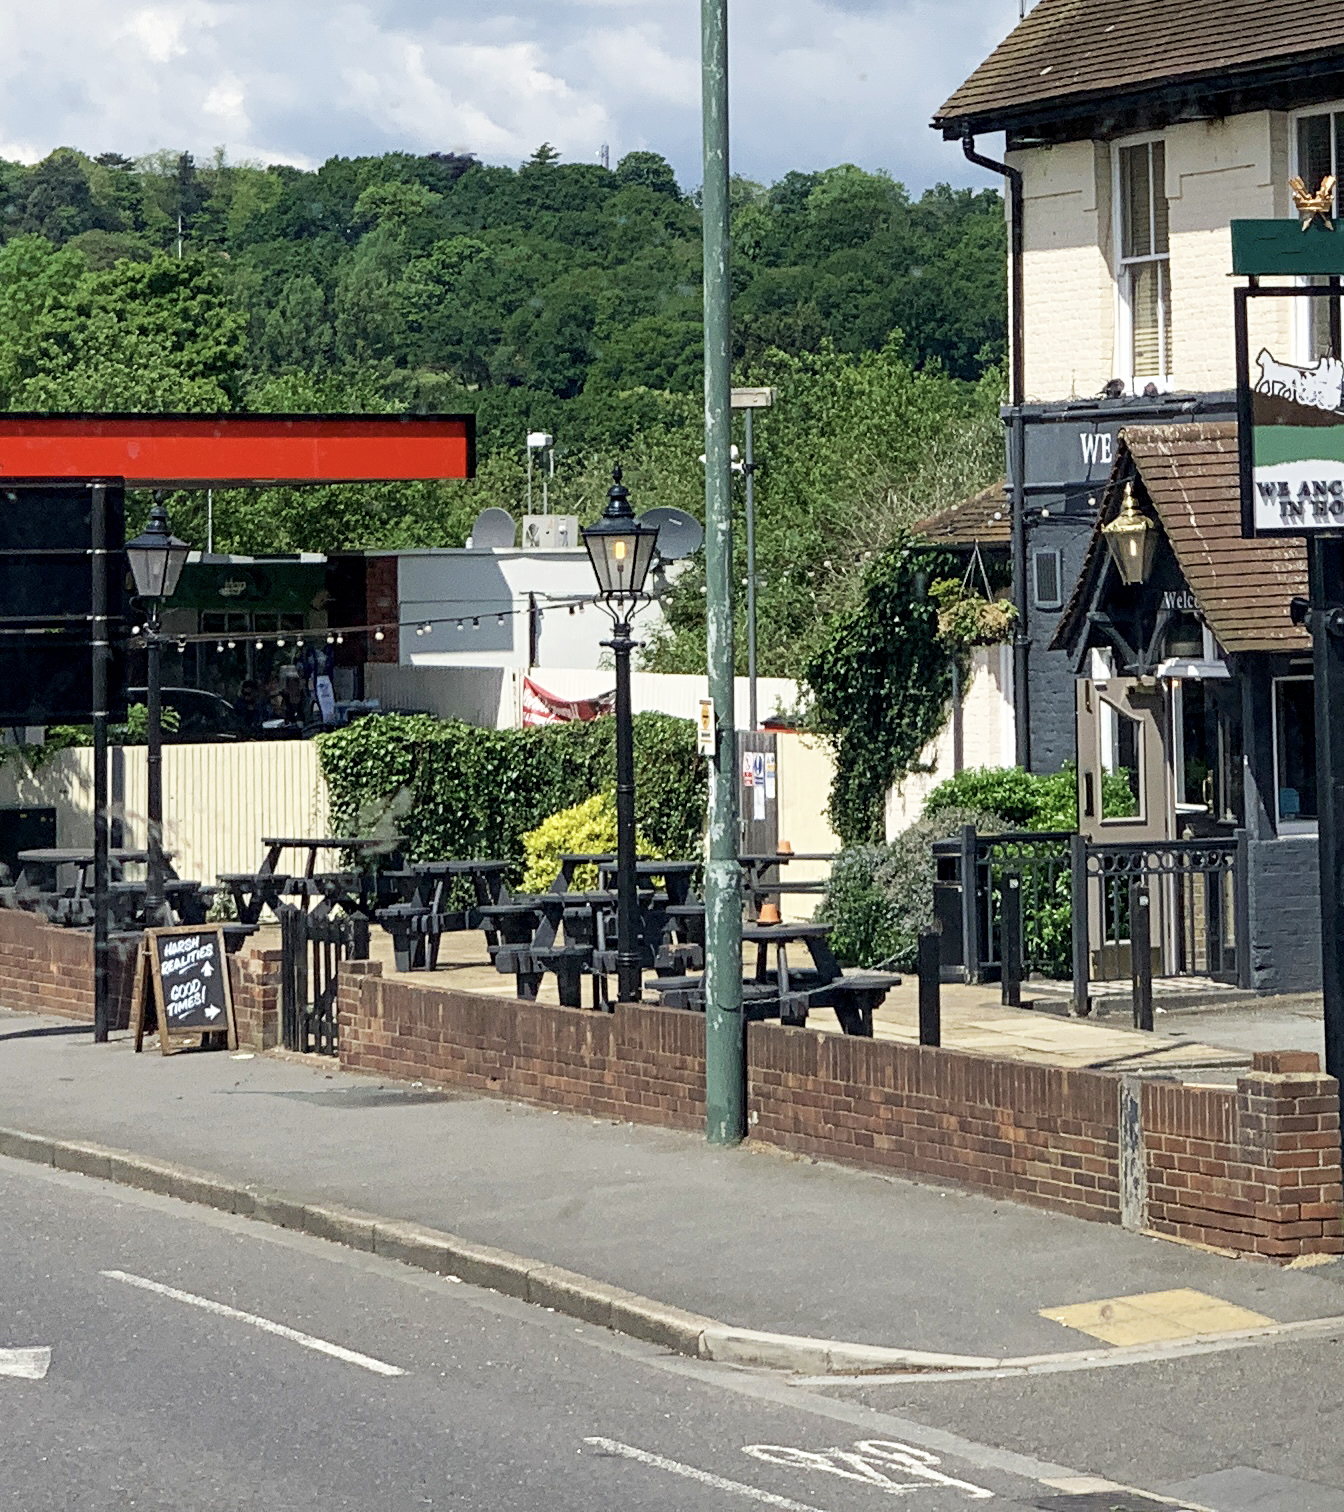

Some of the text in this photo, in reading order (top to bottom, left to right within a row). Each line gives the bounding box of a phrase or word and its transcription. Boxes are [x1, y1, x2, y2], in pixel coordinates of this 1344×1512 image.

[1079, 432, 1113, 465] WE
[1256, 480, 1291, 497] WE
[1279, 500, 1305, 517] IN
[163, 935, 200, 957] HARSH
[161, 943, 214, 975] REALITIES
[166, 985, 207, 1017] TIMES!
[170, 978, 201, 1001] GOOD
